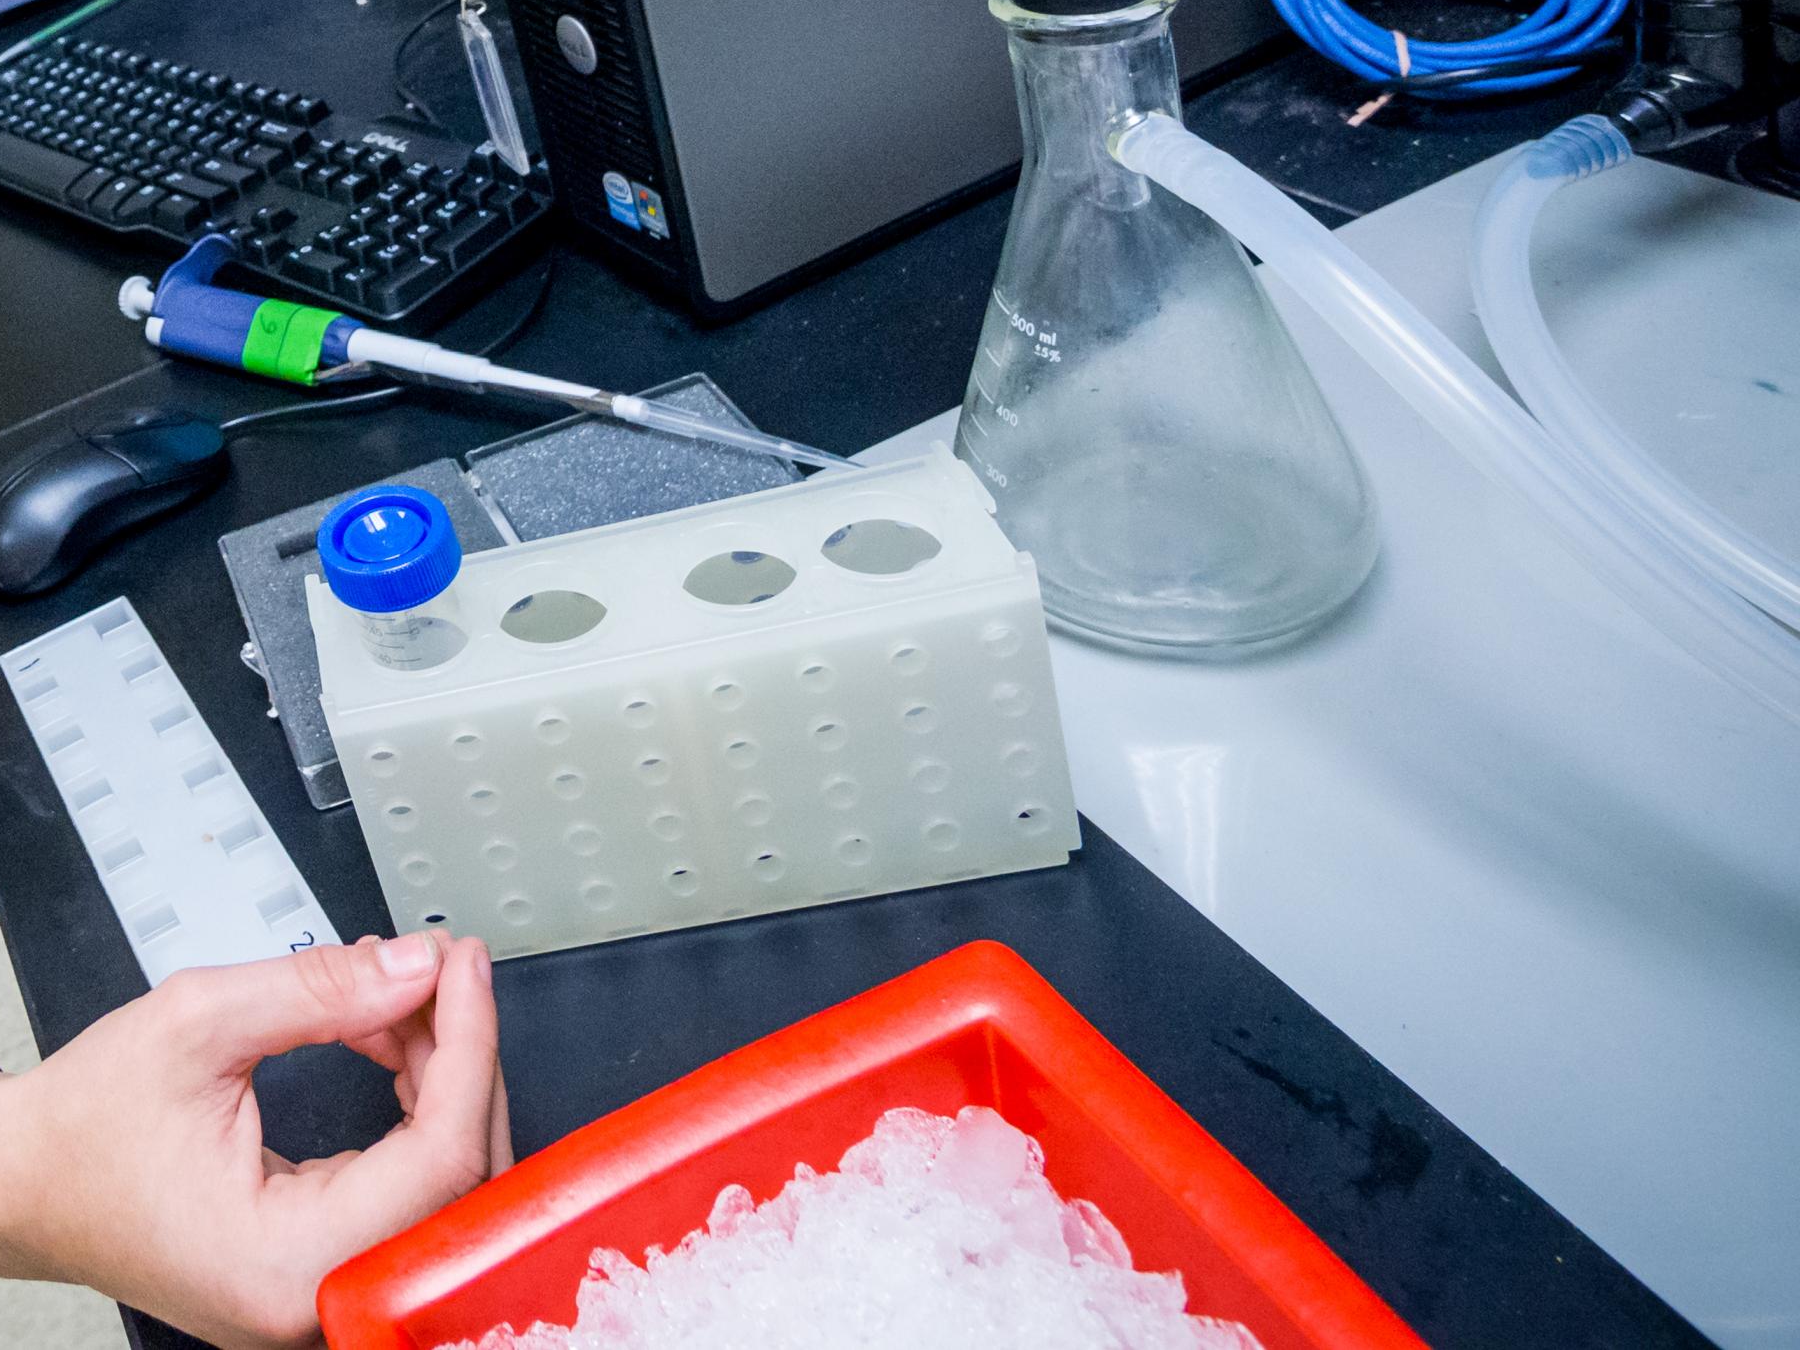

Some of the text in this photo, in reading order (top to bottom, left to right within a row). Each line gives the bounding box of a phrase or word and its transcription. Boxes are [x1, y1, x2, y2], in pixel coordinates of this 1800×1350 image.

[1011, 313, 1057, 346] 500 ml
[1033, 344, 1061, 362] ±5%
[996, 405, 1018, 427] 400
[985, 463, 1007, 488] 300
